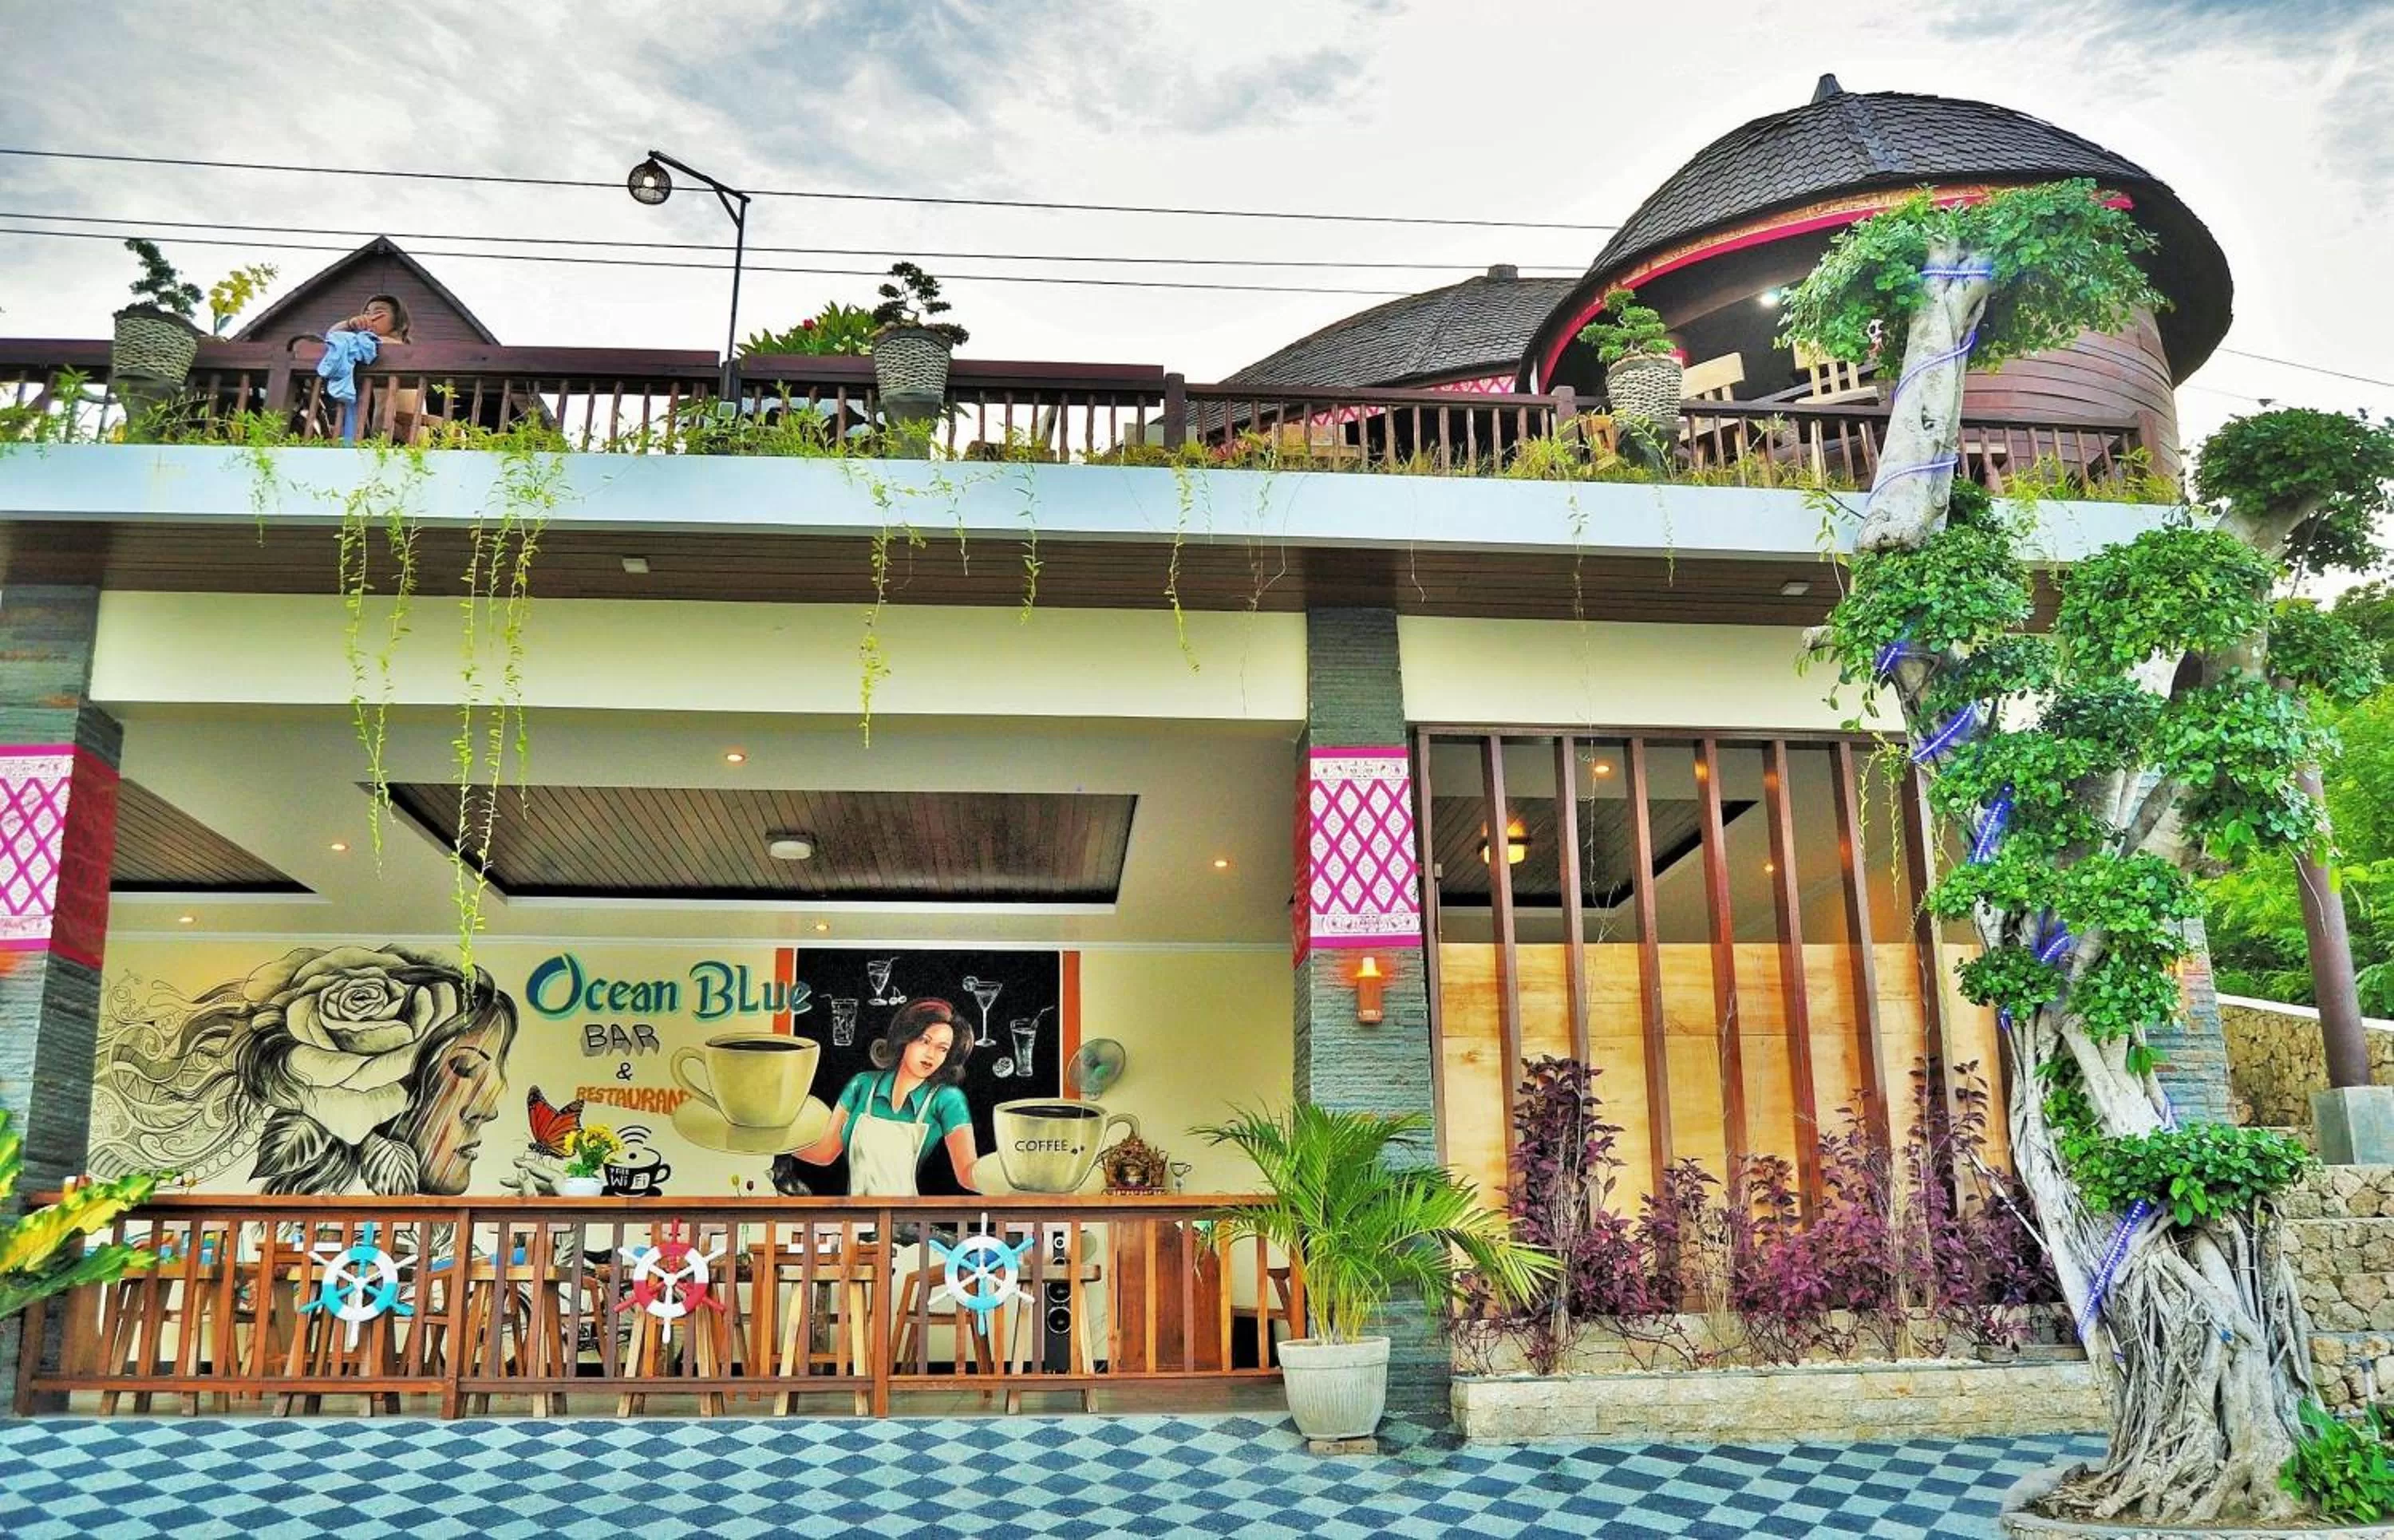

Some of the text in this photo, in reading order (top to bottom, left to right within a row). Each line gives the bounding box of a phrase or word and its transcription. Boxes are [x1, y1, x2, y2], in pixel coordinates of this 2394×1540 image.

[526, 953, 680, 1018] Ocean
[581, 1024, 661, 1057] BAR
[616, 1062, 633, 1080] &
[1014, 1139, 1069, 1151] COFFEE
